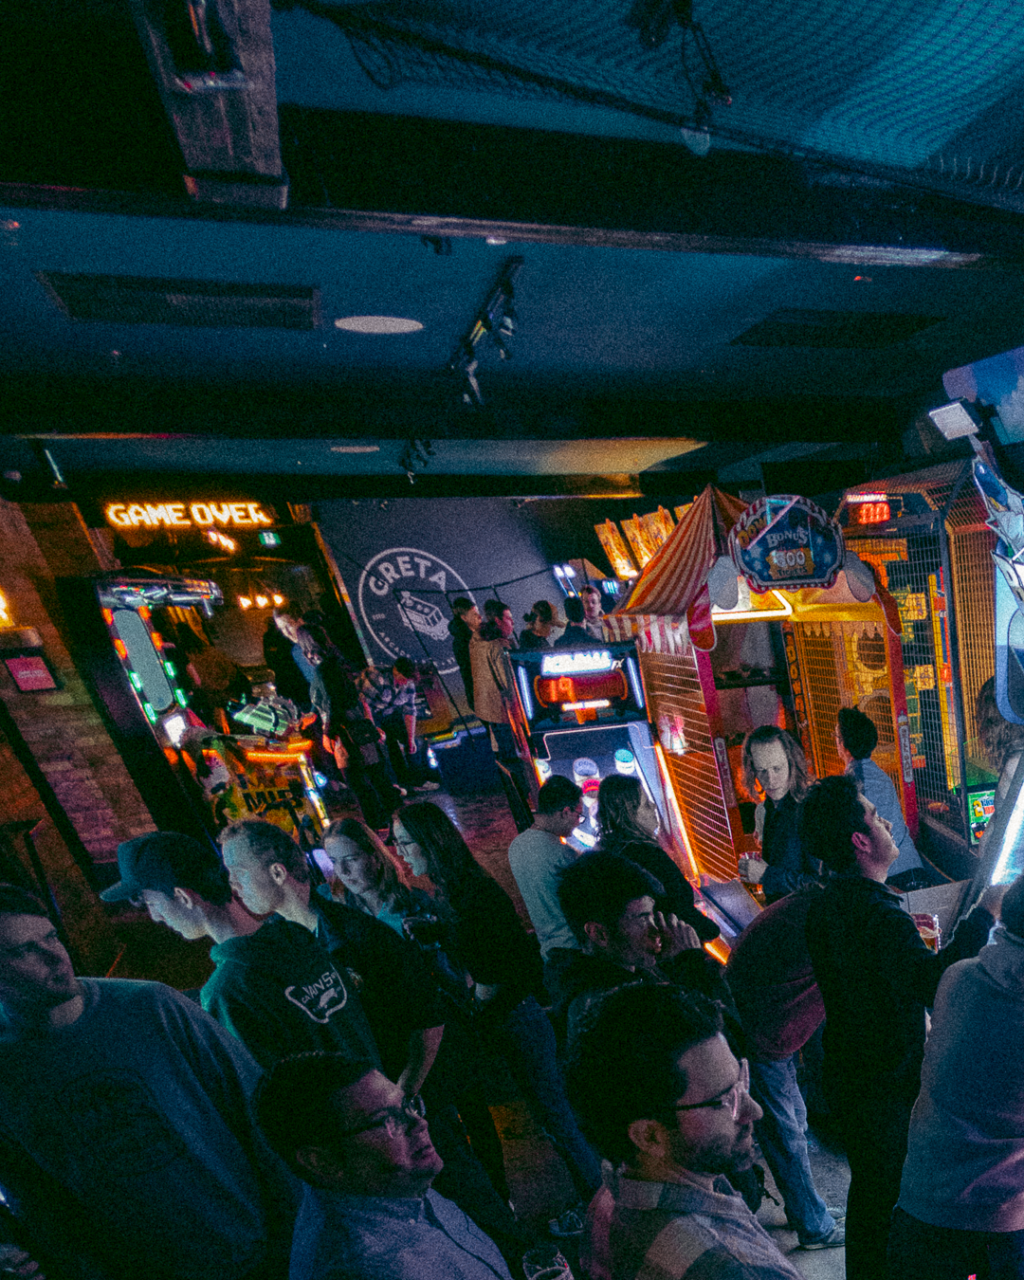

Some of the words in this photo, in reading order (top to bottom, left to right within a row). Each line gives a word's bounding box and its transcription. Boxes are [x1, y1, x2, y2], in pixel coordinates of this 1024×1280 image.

[106, 502, 191, 525] GAME
[189, 502, 265, 524] OVER
[766, 525, 808, 548] BONUS
[369, 556, 447, 596] GRETA
